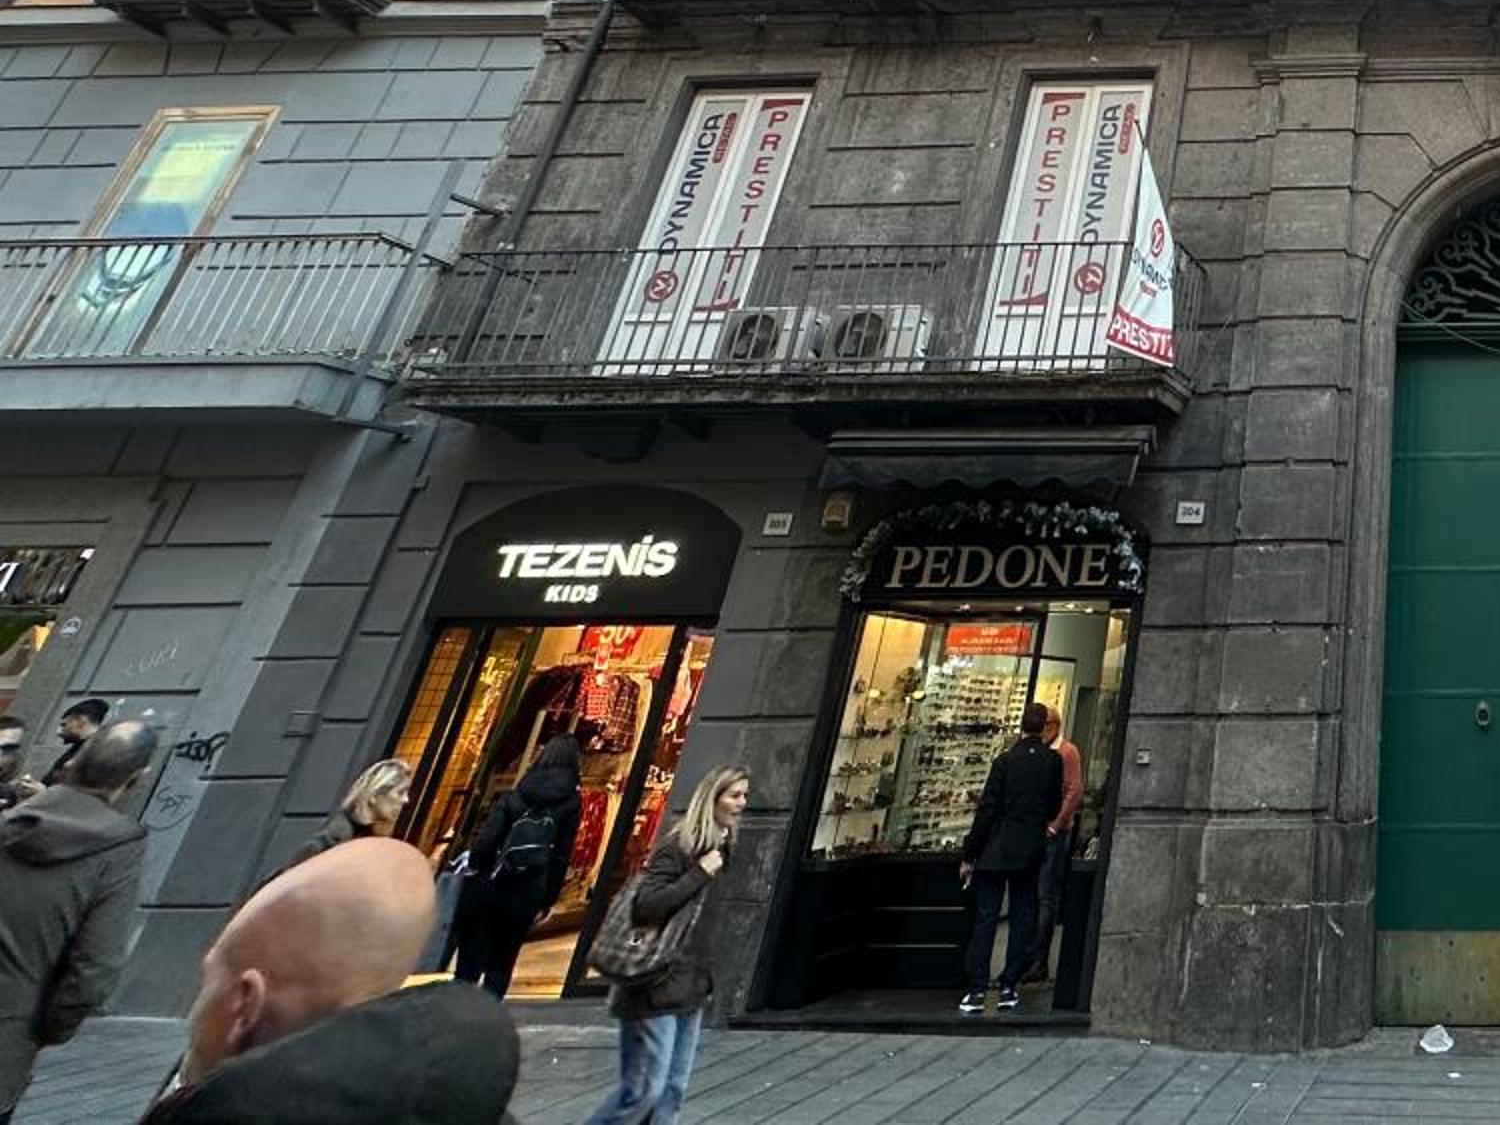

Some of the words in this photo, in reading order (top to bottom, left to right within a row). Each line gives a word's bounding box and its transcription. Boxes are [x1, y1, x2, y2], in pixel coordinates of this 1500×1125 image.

[659, 113, 725, 255] DYNAMICA
[717, 110, 789, 300] PRESTITI
[1023, 104, 1071, 294] PRESTITI
[1080, 103, 1123, 244] DYNAMICA
[544, 584, 599, 603] KIDS
[884, 544, 1112, 588] PEDONE
